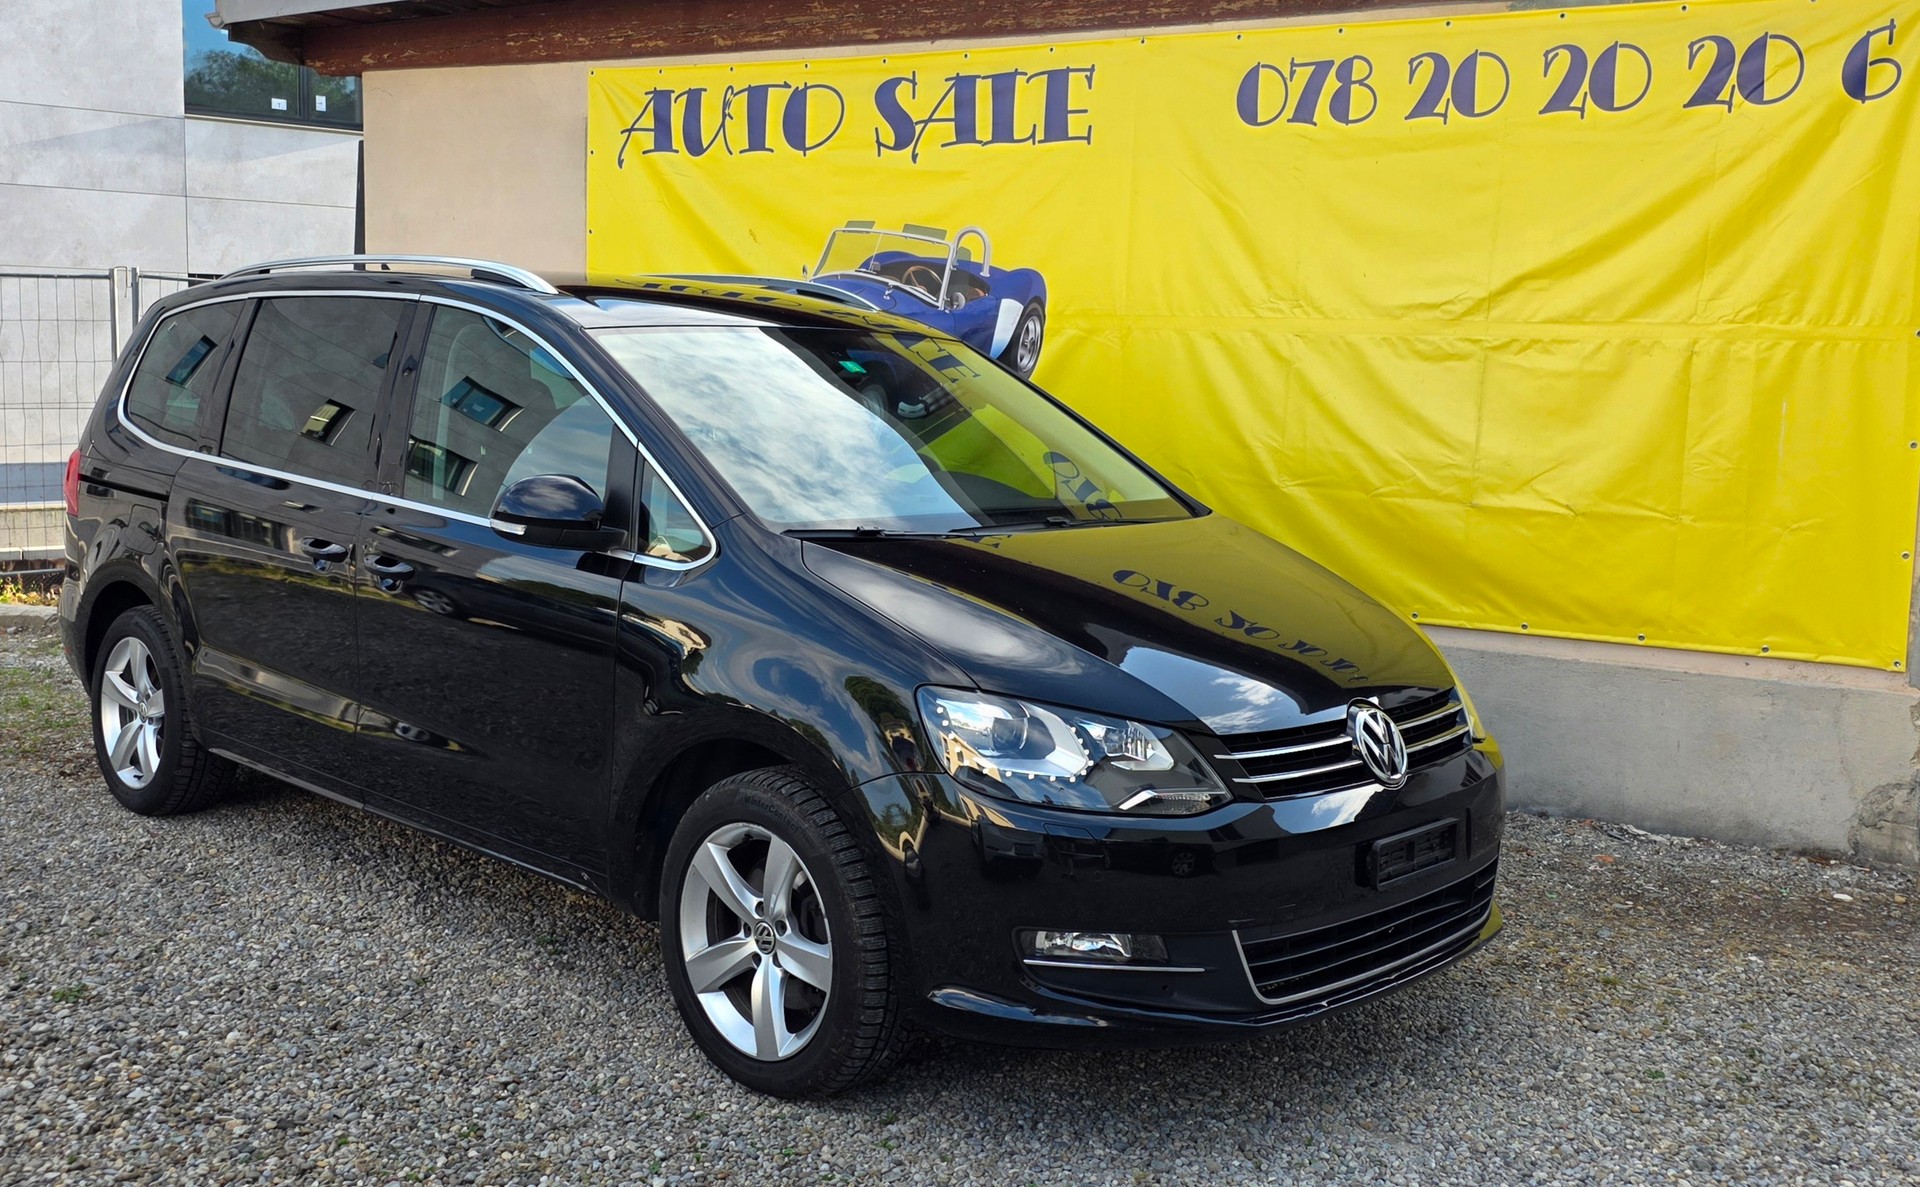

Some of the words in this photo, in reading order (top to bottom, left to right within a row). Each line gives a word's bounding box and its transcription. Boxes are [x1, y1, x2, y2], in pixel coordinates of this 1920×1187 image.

[617, 82, 844, 168] AUTO
[874, 63, 1096, 164] SALE
[1236, 55, 1378, 127] 078
[1405, 49, 1510, 125] 20
[1538, 41, 1652, 120] 20
[1683, 31, 1805, 114] 20
[1841, 18, 1903, 104] 6
[743, 794, 802, 833] WinterContact
